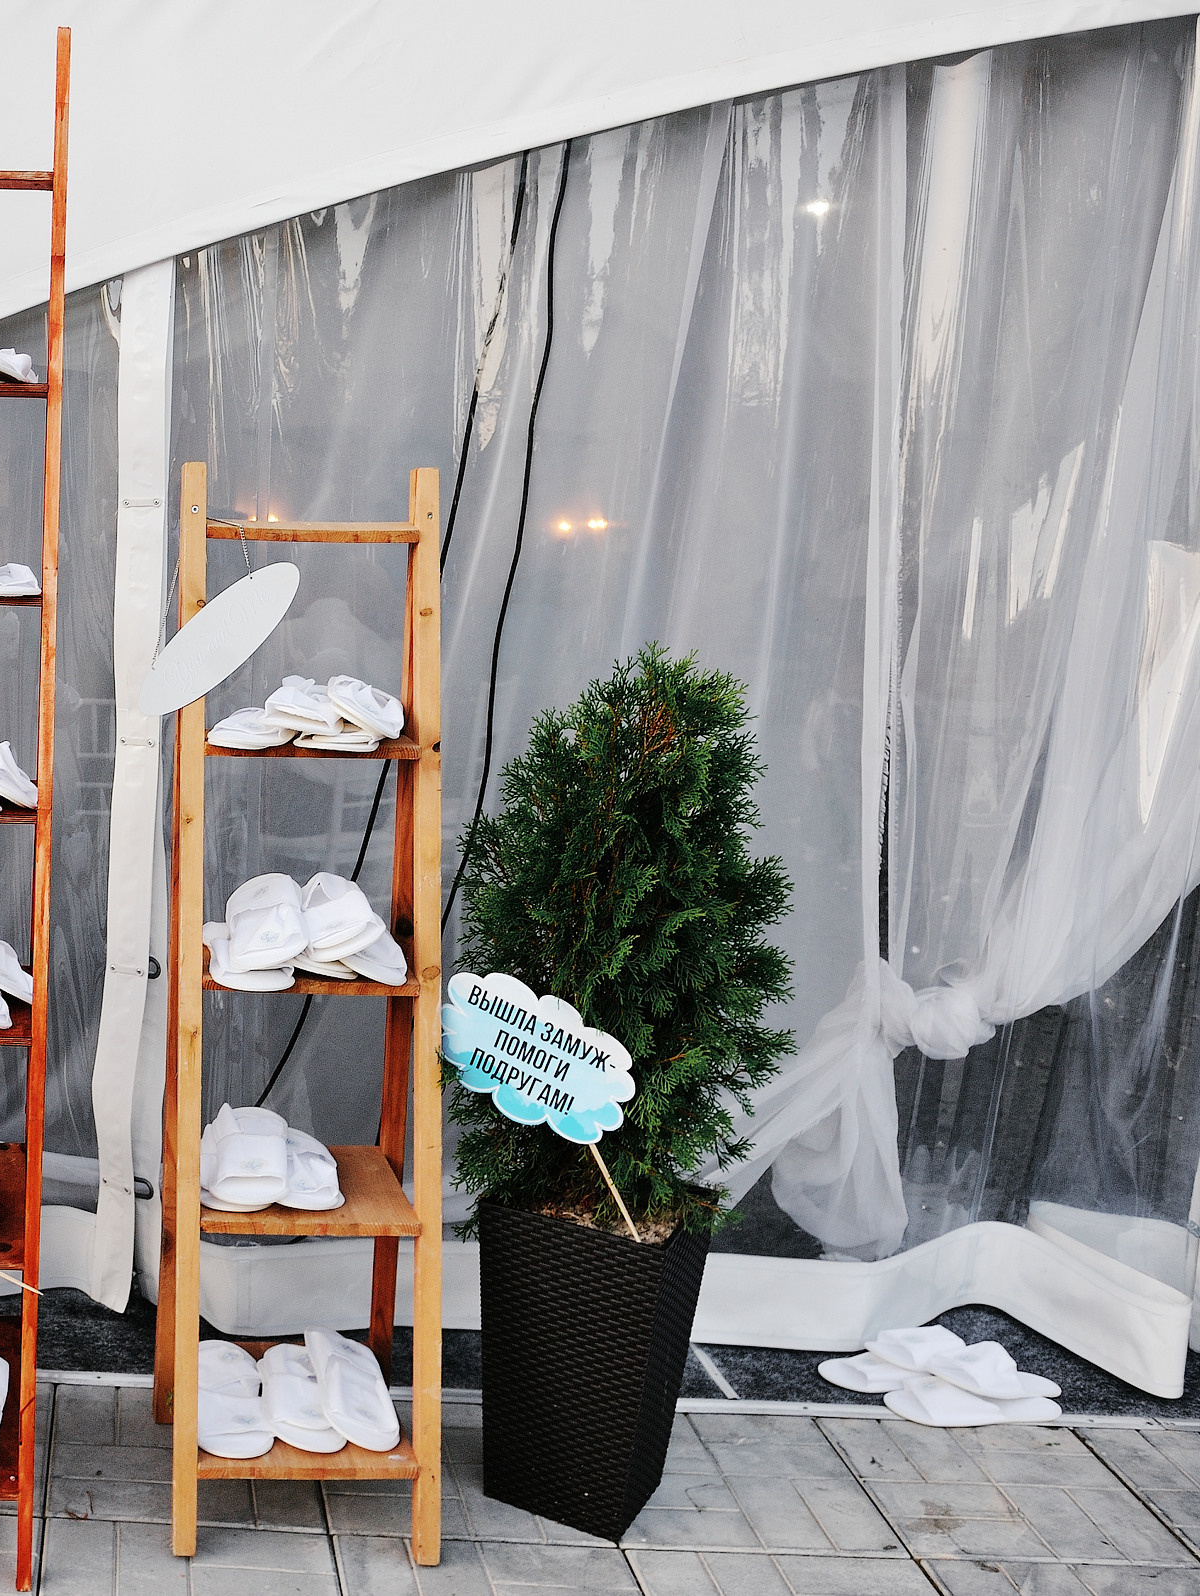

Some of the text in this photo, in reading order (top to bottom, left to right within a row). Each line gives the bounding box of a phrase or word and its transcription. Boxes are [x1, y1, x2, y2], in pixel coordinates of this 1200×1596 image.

[467, 984, 538, 1036] ВЫШЛА
[469, 1047, 576, 1116] ПОДРУГАМ!
[493, 1029, 571, 1082] ПОМОГИ
